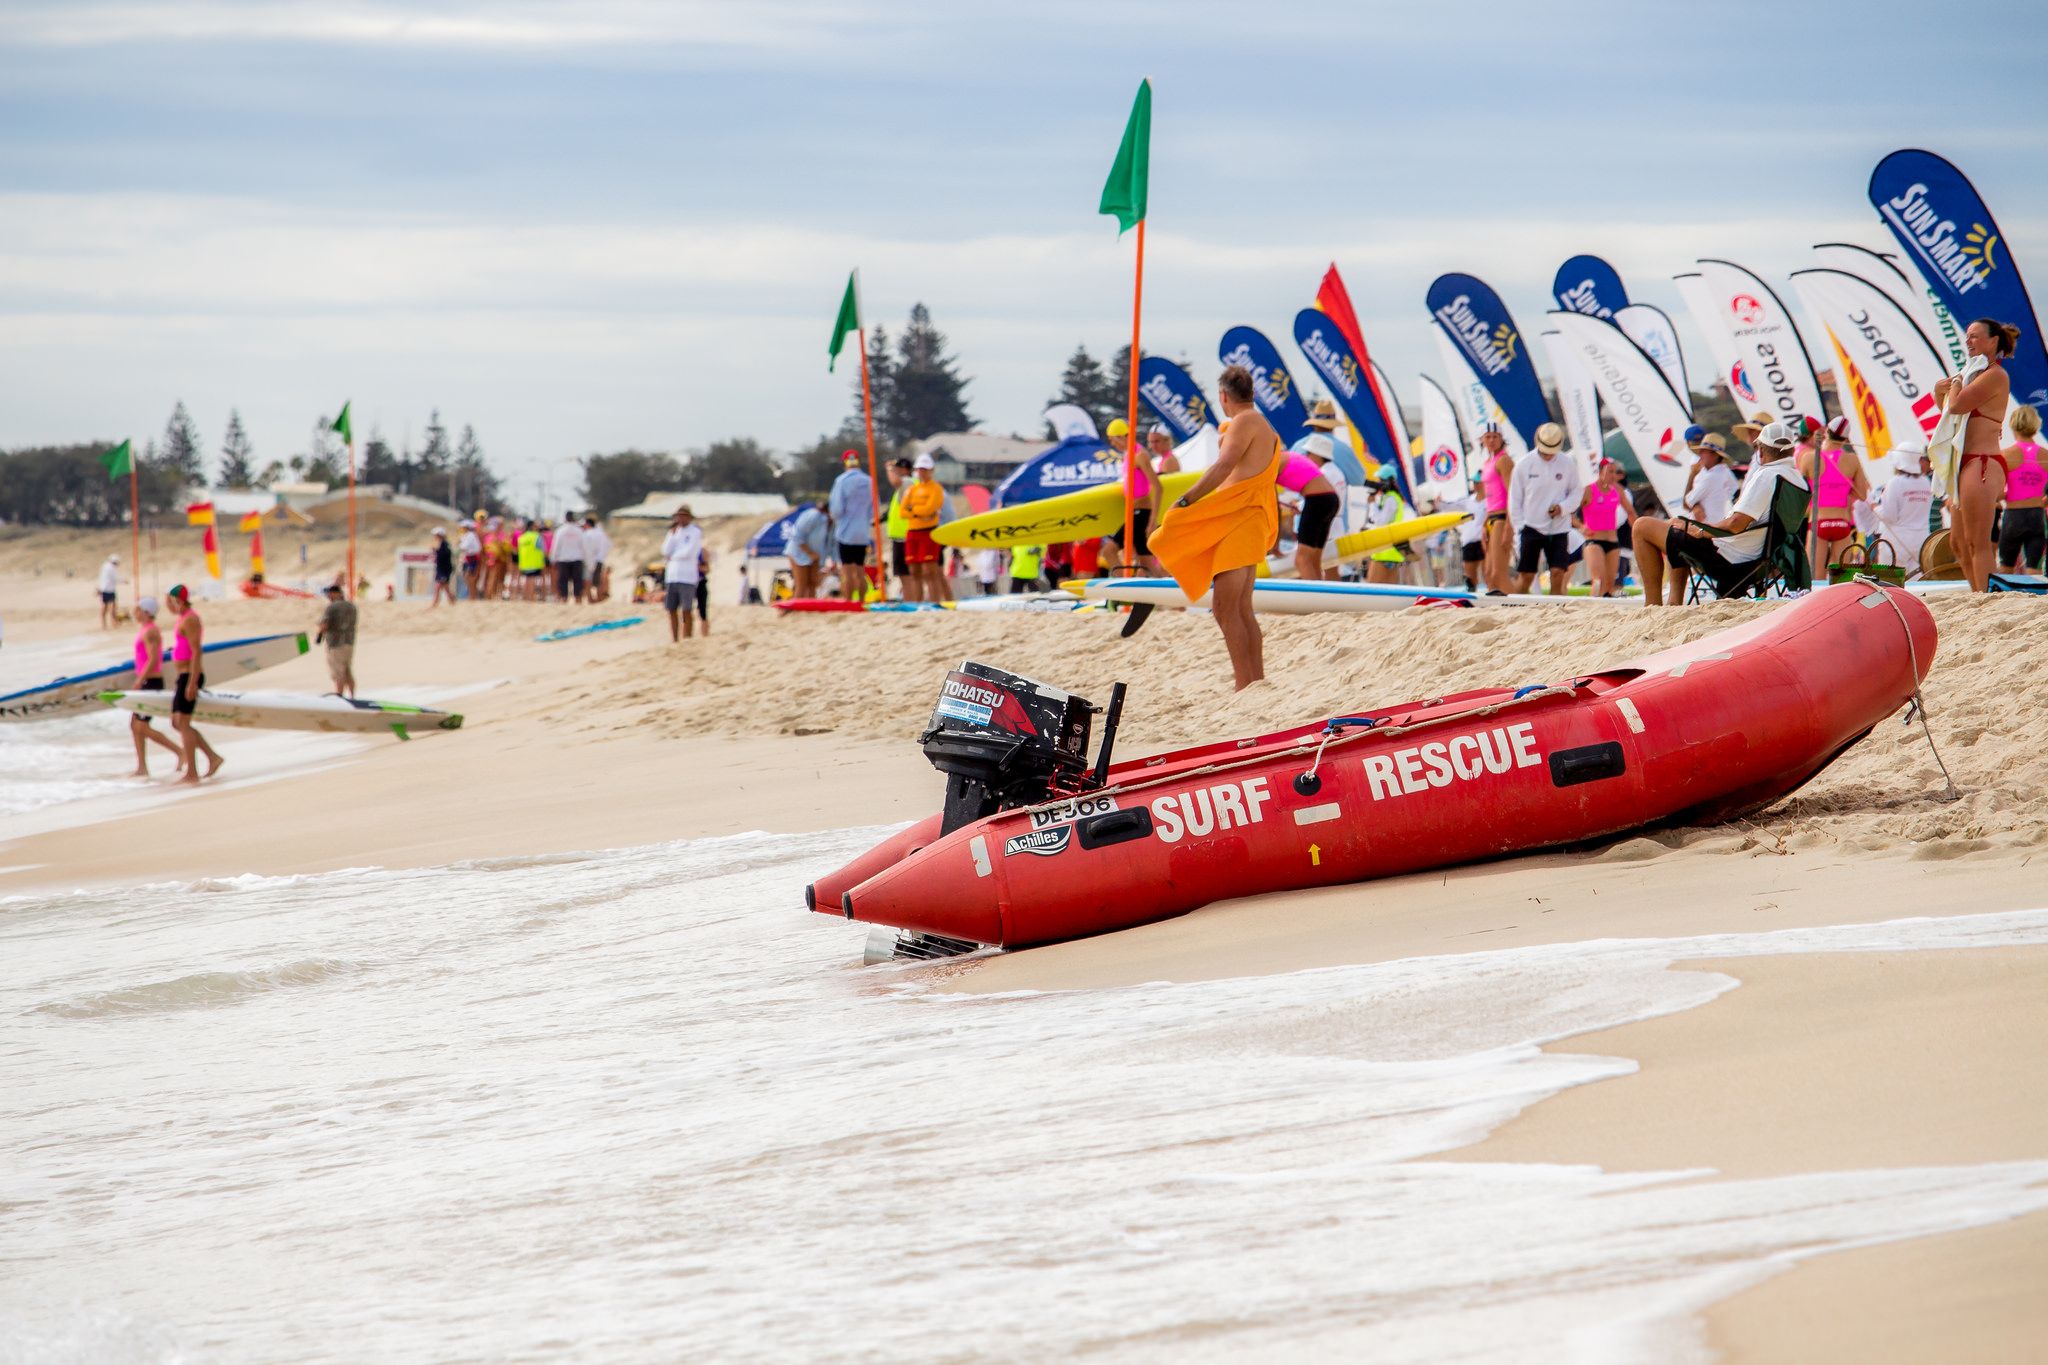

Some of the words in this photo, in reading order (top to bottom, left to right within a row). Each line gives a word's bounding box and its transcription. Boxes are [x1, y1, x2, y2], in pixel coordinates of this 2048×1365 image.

[944, 679, 1005, 708] TOHATSU
[1151, 776, 1271, 843] SURF
[1362, 721, 1542, 801] RESCUE
[1006, 831, 1059, 855] Achilles
